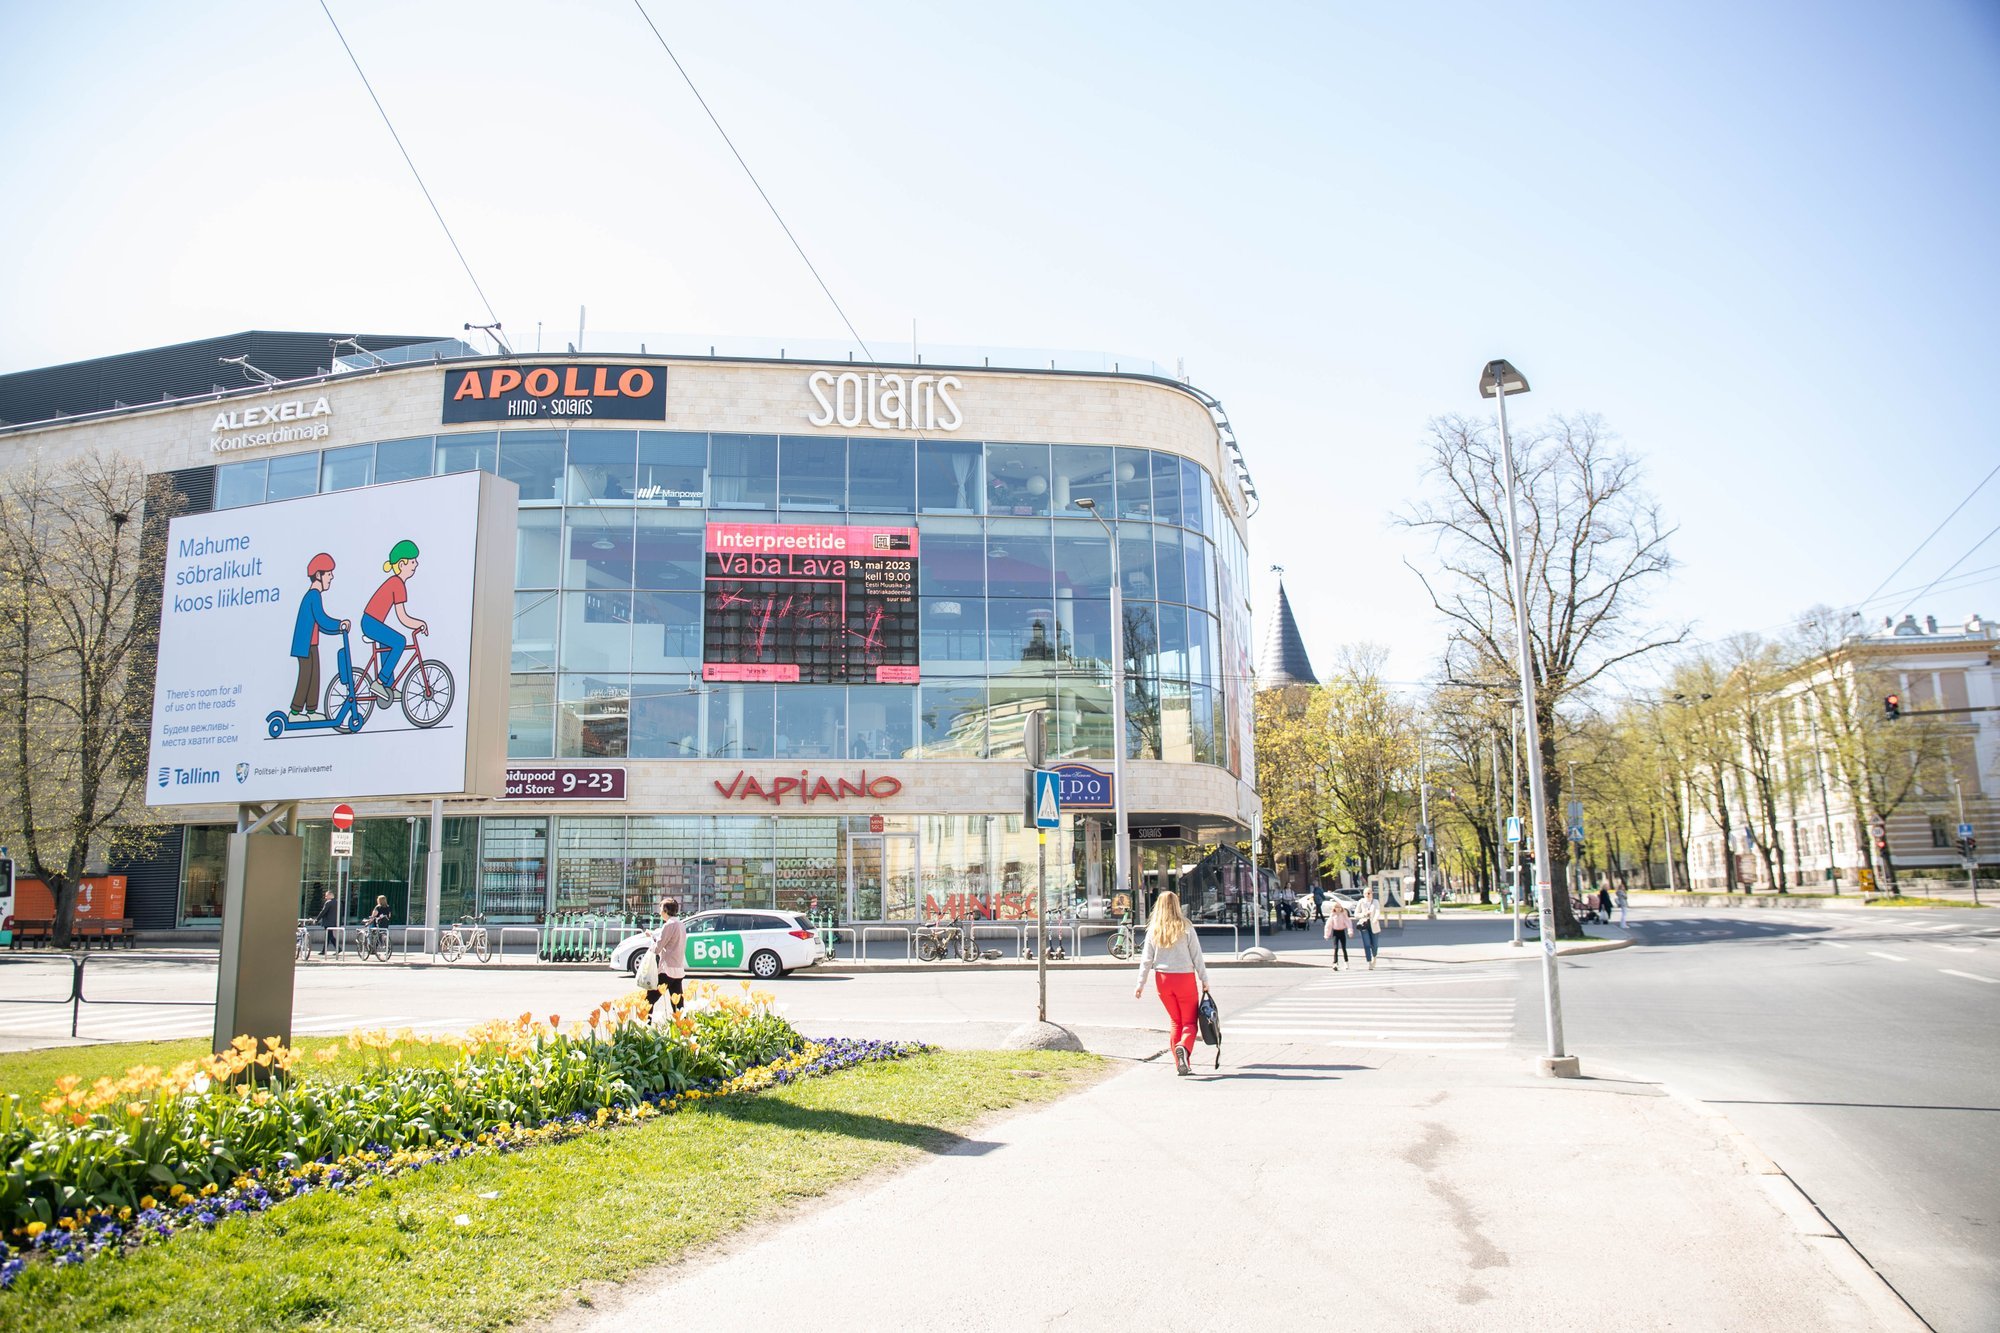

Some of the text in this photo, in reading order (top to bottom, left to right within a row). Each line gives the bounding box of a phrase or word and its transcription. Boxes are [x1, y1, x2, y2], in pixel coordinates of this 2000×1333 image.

[453, 367, 655, 401] APOLLO
[211, 396, 333, 433] ALEXELA
[209, 421, 329, 453] Kontserdimaja
[661, 488, 705, 499] Manpower
[179, 535, 251, 558] Mahume
[716, 530, 847, 552] Interpreetide
[176, 556, 263, 586] sõbralikult
[717, 552, 847, 577] Vaba Lava
[849, 560, 911, 570] 19. mai 2023
[865, 571, 911, 582] kell 19.00
[174, 586, 281, 614] koos liiklema
[166, 684, 243, 700] There's room for all
[164, 698, 237, 713] of us on the roads
[163, 724, 190, 737] Будем
[190, 723, 230, 733] вежливы
[161, 735, 239, 748] места хватит всем
[174, 767, 220, 785] Tallinn
[280, 767, 287, 776] ja
[287, 764, 333, 774] Piirivalveamet
[525, 783, 556, 795] Store
[1059, 779, 1101, 795] IDO
[693, 940, 735, 961] Bolt
